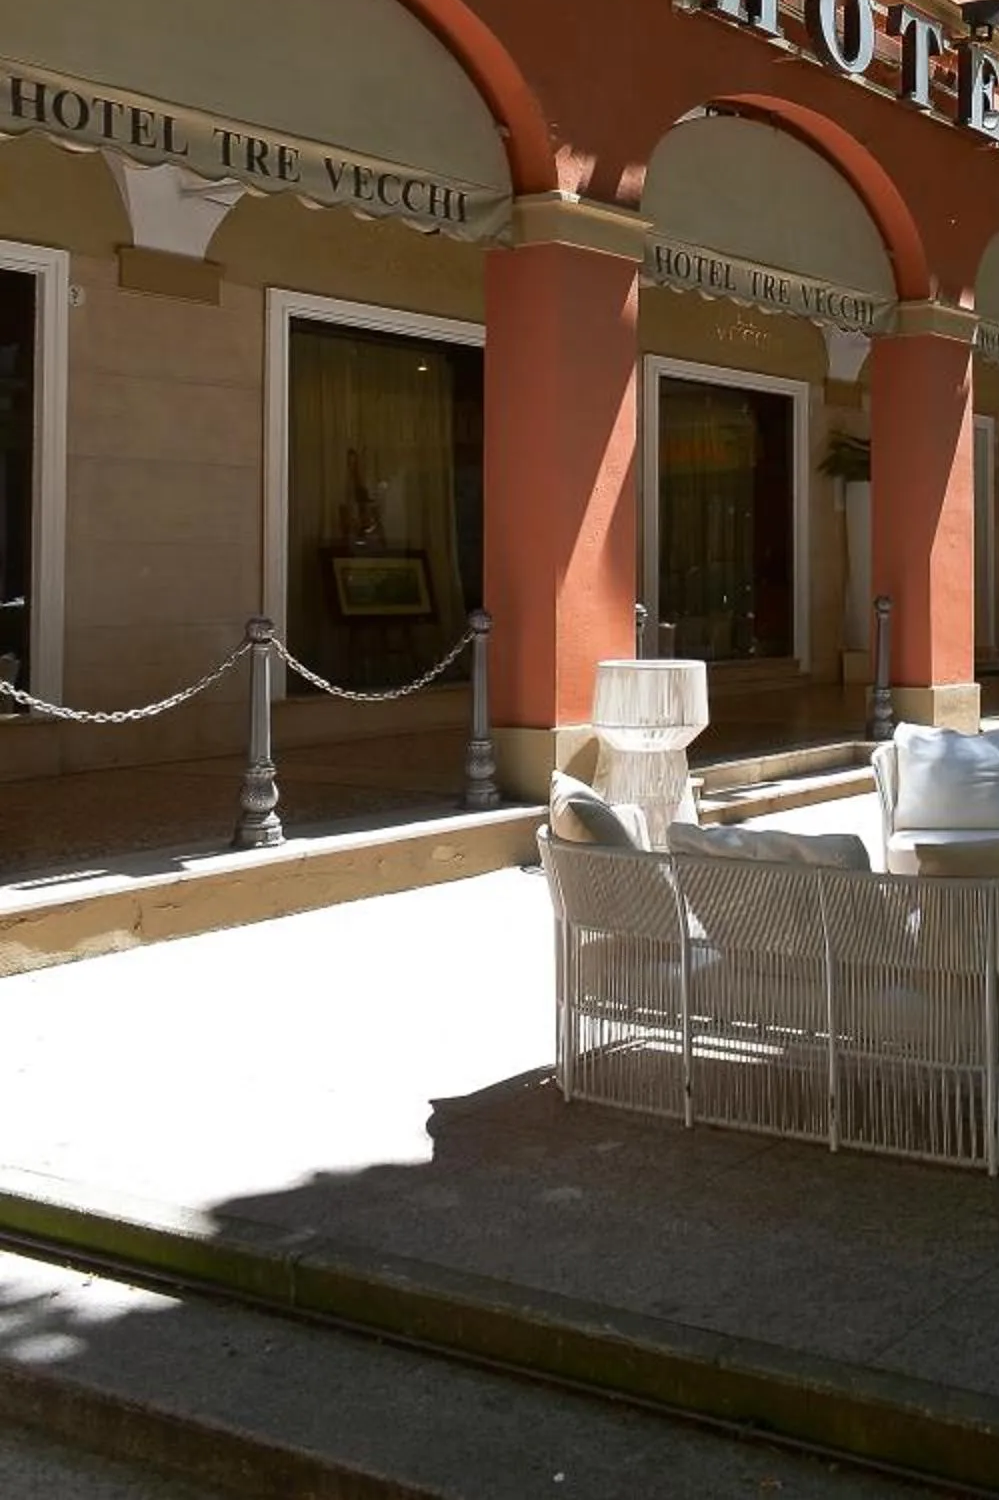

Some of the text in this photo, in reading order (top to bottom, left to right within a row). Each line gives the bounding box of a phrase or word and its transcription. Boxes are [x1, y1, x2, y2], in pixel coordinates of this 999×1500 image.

[9, 77, 469, 223] HOTEL TRE VECCHI
[655, 245, 875, 326] HOTEL TRE VECCHI
